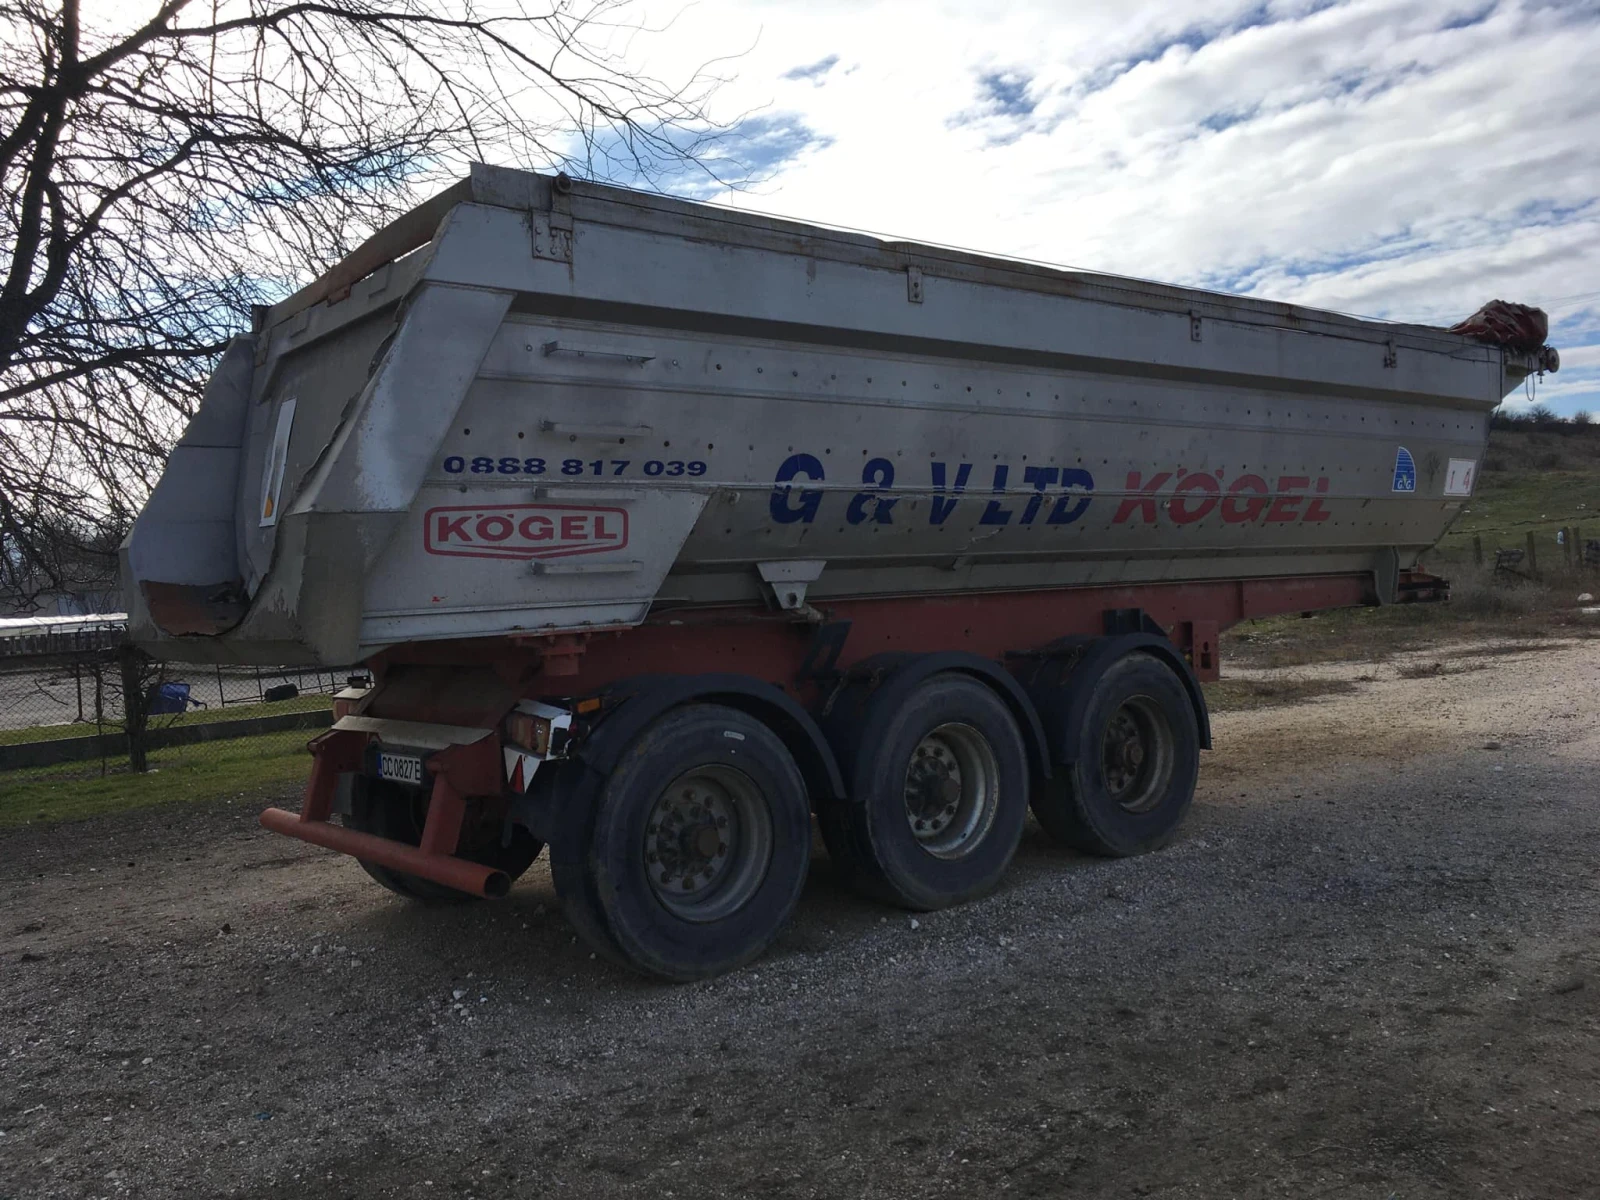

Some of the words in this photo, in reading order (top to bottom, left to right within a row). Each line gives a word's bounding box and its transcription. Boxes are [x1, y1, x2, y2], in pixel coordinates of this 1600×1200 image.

[443, 456, 546, 474] 0888
[561, 458, 630, 476] 817
[643, 460, 707, 476] 039
[768, 454, 825, 524] G
[845, 457, 896, 525] &
[928, 462, 972, 525] V
[979, 464, 1095, 525] LTD
[1112, 467, 1332, 524] KÖGEL
[437, 513, 618, 542] KÖGEL
